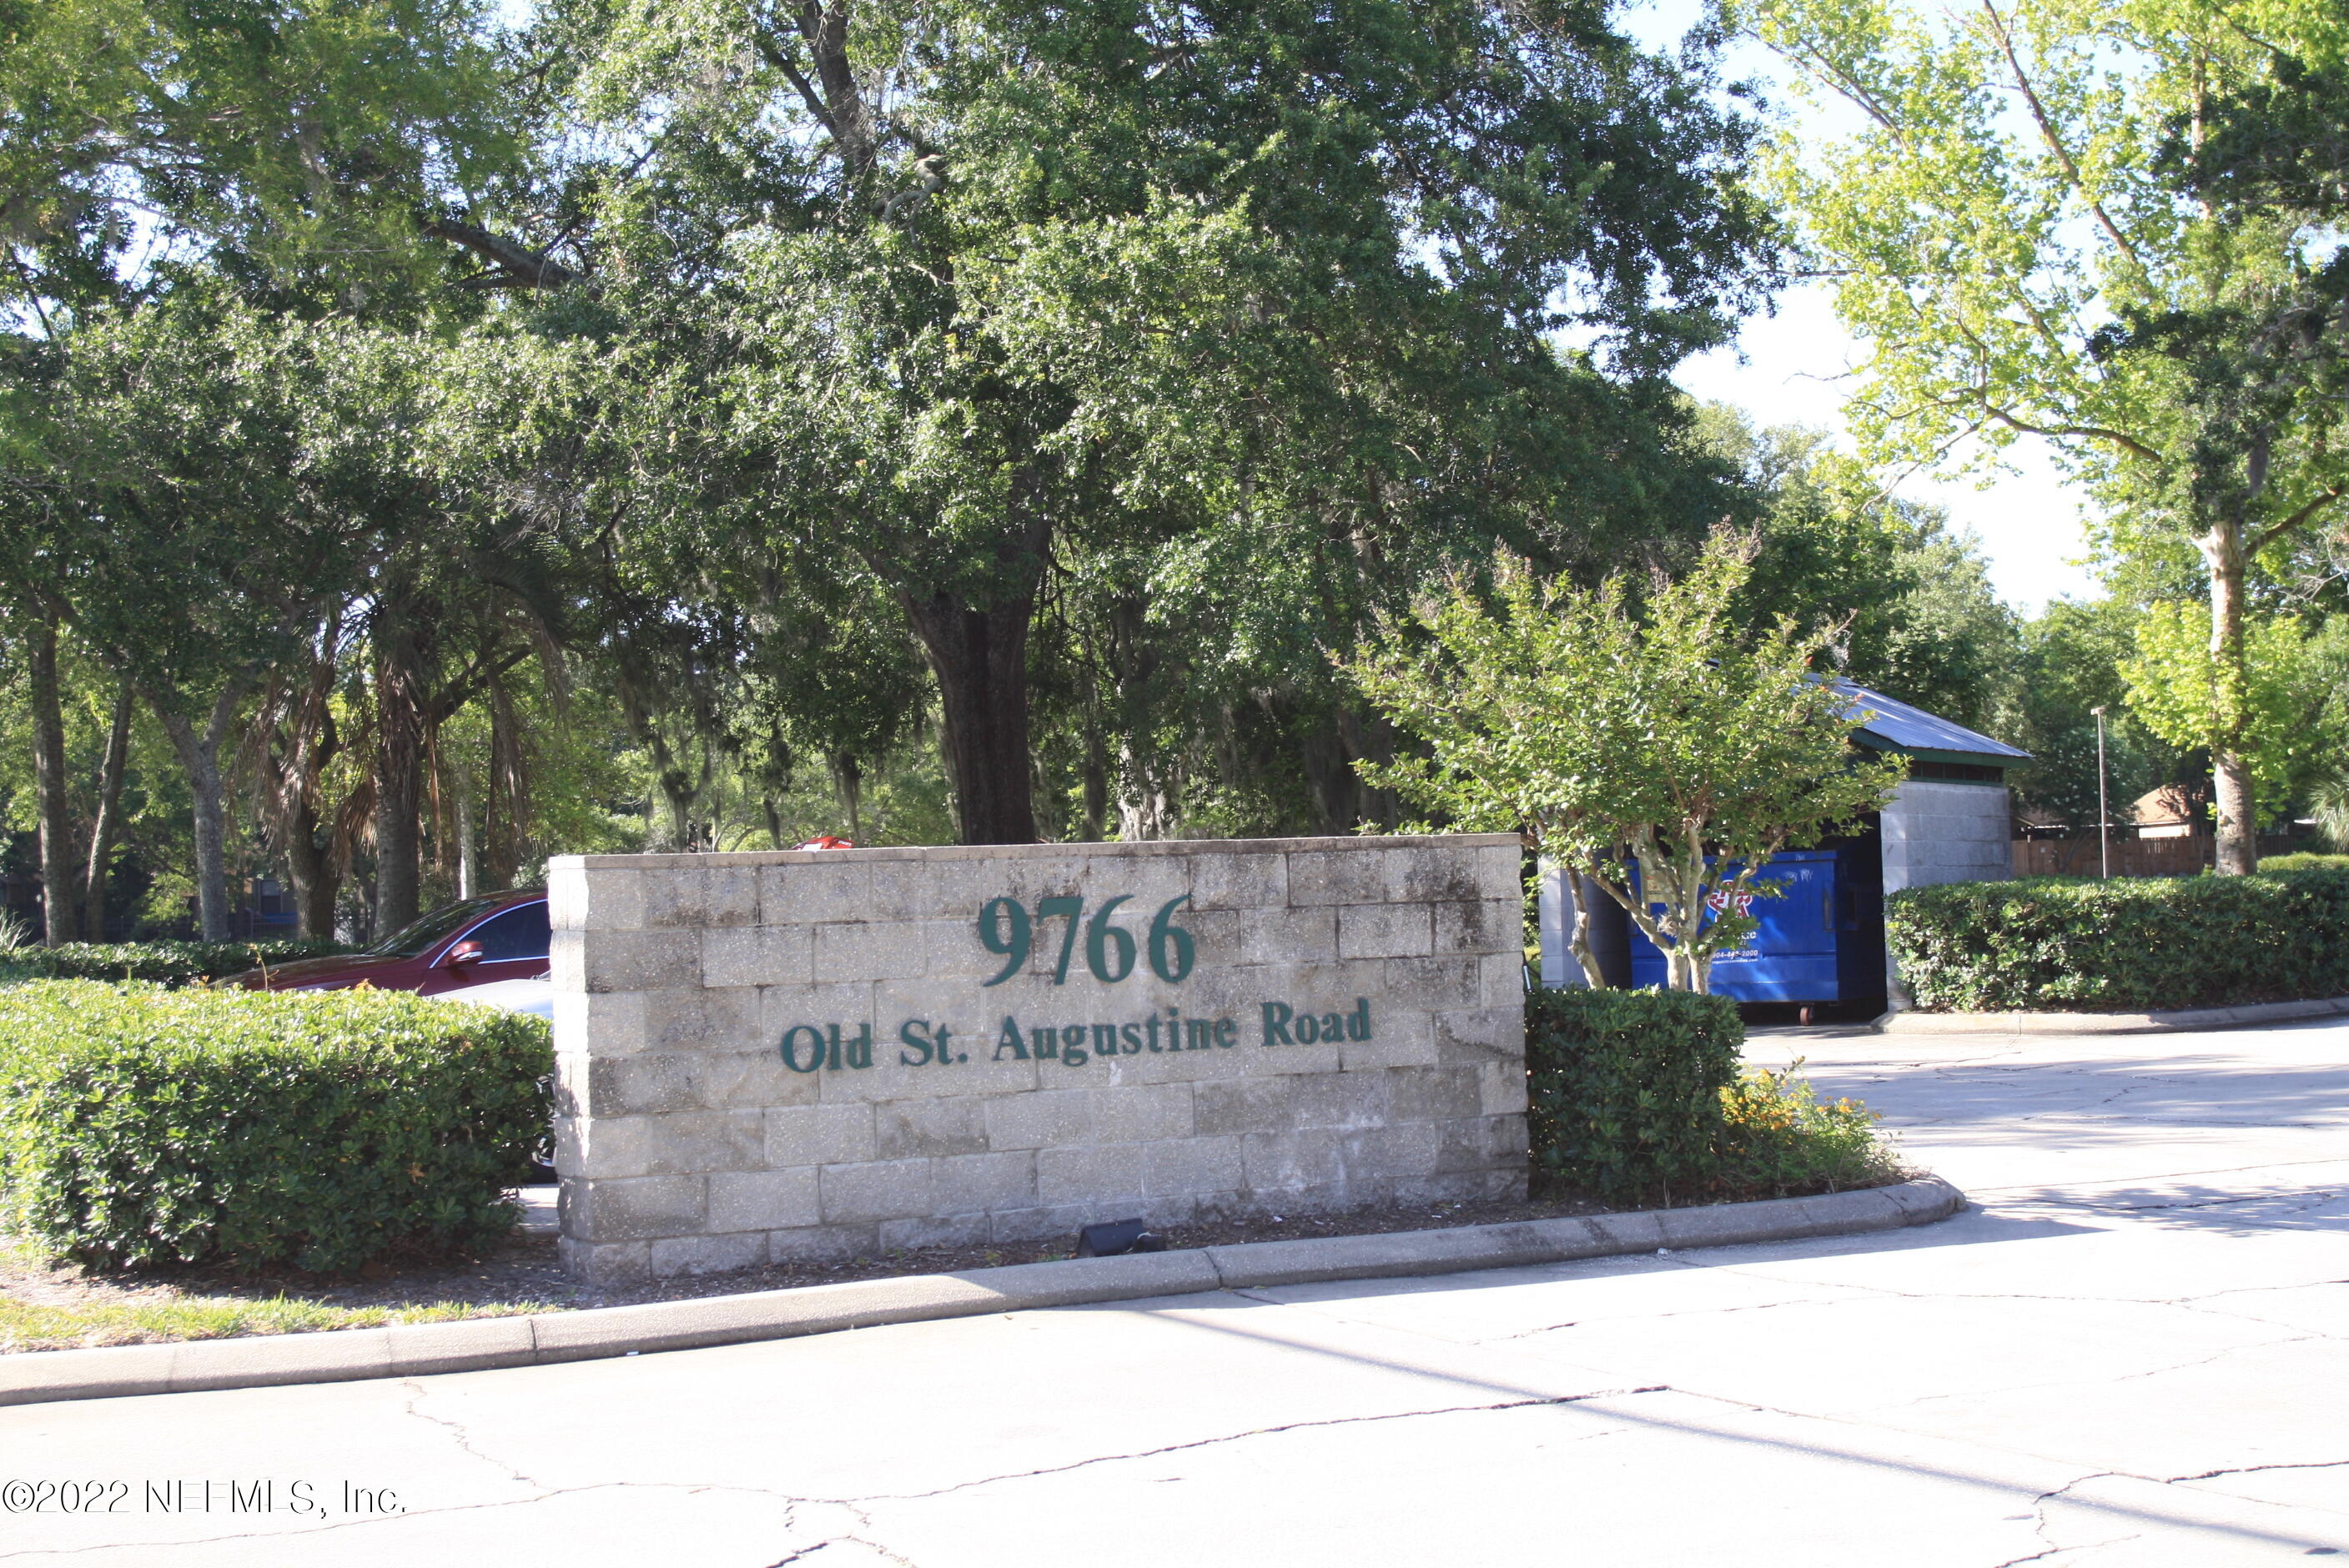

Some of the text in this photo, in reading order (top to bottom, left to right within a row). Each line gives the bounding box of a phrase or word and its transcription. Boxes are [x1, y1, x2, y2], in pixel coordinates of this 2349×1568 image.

[978, 894, 1195, 987] 9766
[781, 998, 1372, 1073] Old St. Augustine Road
